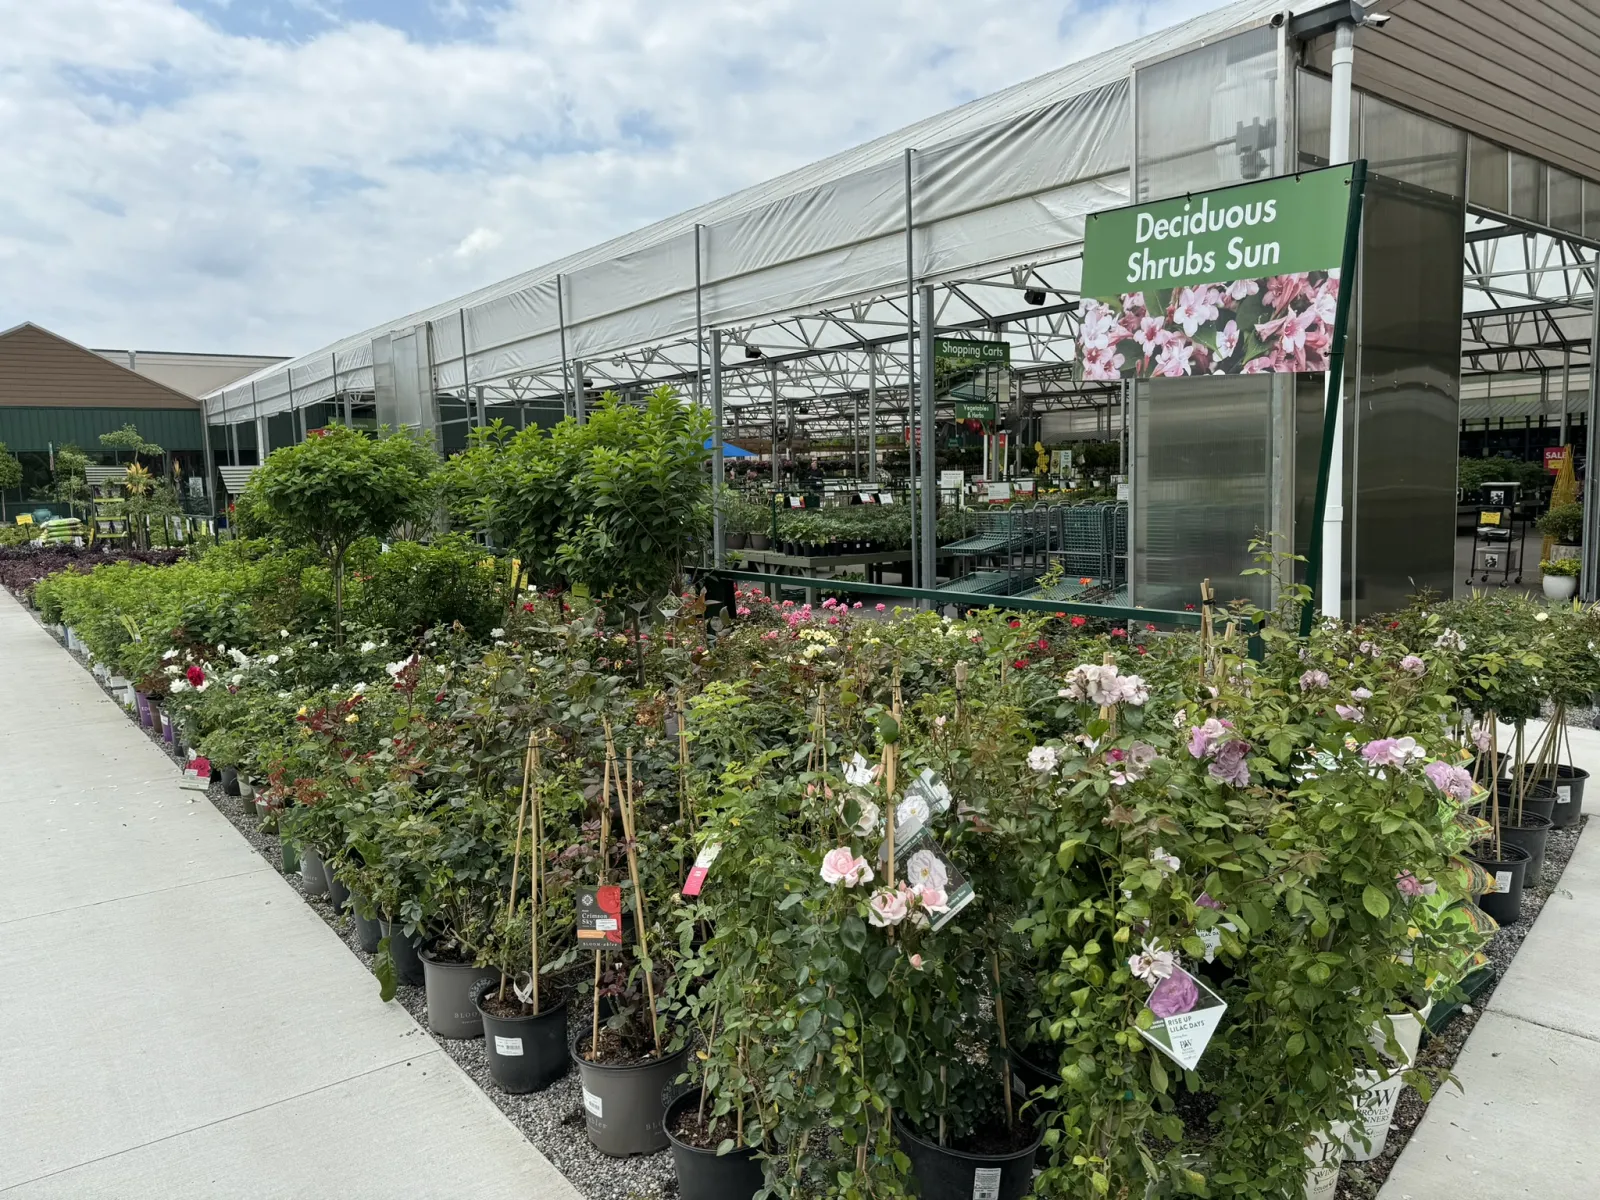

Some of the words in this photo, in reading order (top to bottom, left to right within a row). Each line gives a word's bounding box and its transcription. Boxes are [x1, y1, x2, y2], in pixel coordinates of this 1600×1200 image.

[1135, 197, 1277, 243] Deciduous
[1126, 241, 1215, 283] Shrubs
[1226, 237, 1280, 271] Sun
[942, 341, 980, 358] Shopping
[982, 345, 1003, 357] Carts
[963, 404, 989, 412] Vegetables
[1546, 451, 1566, 459] SALE
[1167, 1017, 1182, 1026] RISE
[1183, 1015, 1192, 1023] UP
[1169, 1024, 1188, 1033] LILAC
[1189, 1020, 1205, 1029] DAYS
